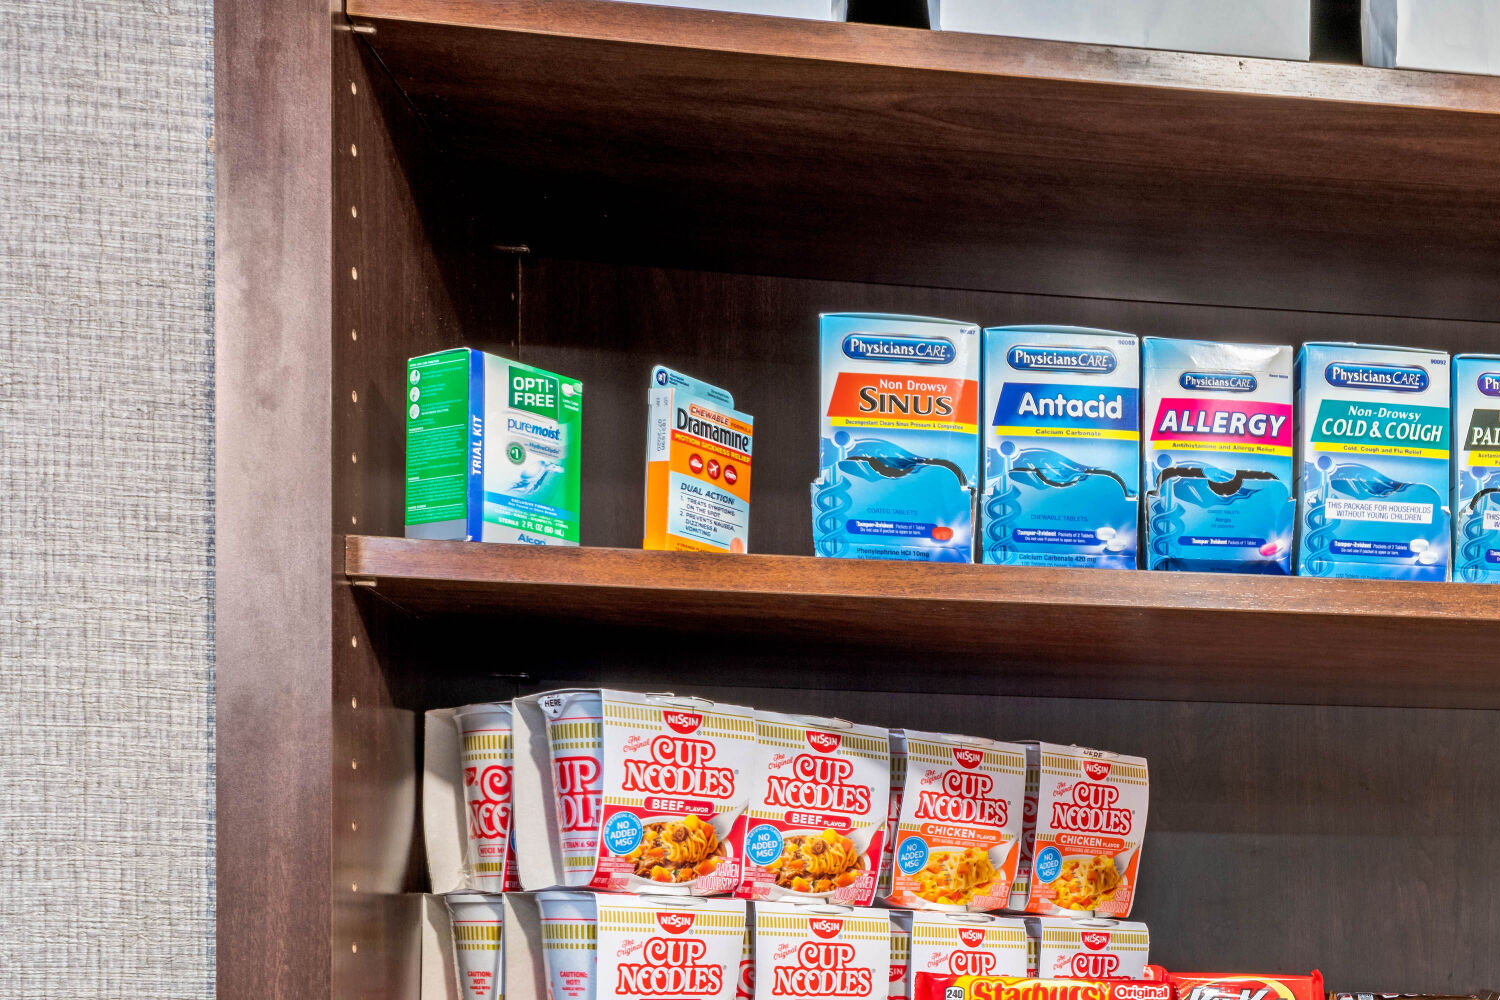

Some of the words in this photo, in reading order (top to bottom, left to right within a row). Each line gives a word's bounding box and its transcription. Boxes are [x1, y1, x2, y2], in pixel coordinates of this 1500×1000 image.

[879, 378, 903, 390] Non
[906, 380, 948, 396] Drowsy
[514, 392, 554, 408] FREE
[858, 386, 953, 416] SINUS
[1018, 391, 1123, 420] Antacid
[690, 406, 730, 426] CHEWABLE
[1158, 410, 1287, 438] ALLERGY
[1348, 404, 1422, 422] Non-Drowsy
[472, 415, 482, 436] KIT
[507, 418, 560, 441] puremoist
[676, 407, 749, 452] Dramamine
[1035, 428, 1064, 436] Calcium
[1066, 429, 1102, 438] Carbonate
[1321, 418, 1367, 438] COLD
[1369, 422, 1382, 438] &
[1384, 422, 1444, 442] COUGH
[472, 440, 482, 475] TRIAL
[680, 482, 703, 496] DUAL
[705, 489, 735, 506] ACTION
[1344, 502, 1372, 510] PACKAGE
[1388, 505, 1432, 514] HOUSEHOLDS
[1390, 512, 1422, 520] CHILDREN
[667, 714, 698, 728] NISSIN
[652, 736, 716, 768] CUP
[810, 734, 838, 747] NISSIN
[623, 761, 734, 799] NOODLES
[793, 754, 854, 784] CUP
[764, 776, 871, 815] NOODLES
[942, 770, 994, 800] CUP
[1072, 781, 1120, 810] CUP
[651, 800, 684, 811] BEEF
[915, 791, 1008, 828] NOODLES
[616, 822, 630, 830] NO
[792, 814, 822, 824] BEEF
[1050, 802, 1132, 835] NOODLES
[610, 829, 638, 840] ADDED
[615, 838, 633, 847] MSG
[926, 826, 976, 838] CHICKEN
[1060, 836, 1102, 846] CHICKEN
[660, 914, 692, 927] NISSIN
[644, 936, 706, 966] CUP
[798, 941, 856, 969] CUP
[616, 962, 724, 996] NOODLES
[772, 966, 876, 998] NOODLES
[946, 989, 964, 1000] 240
[1115, 985, 1170, 1000] Original
